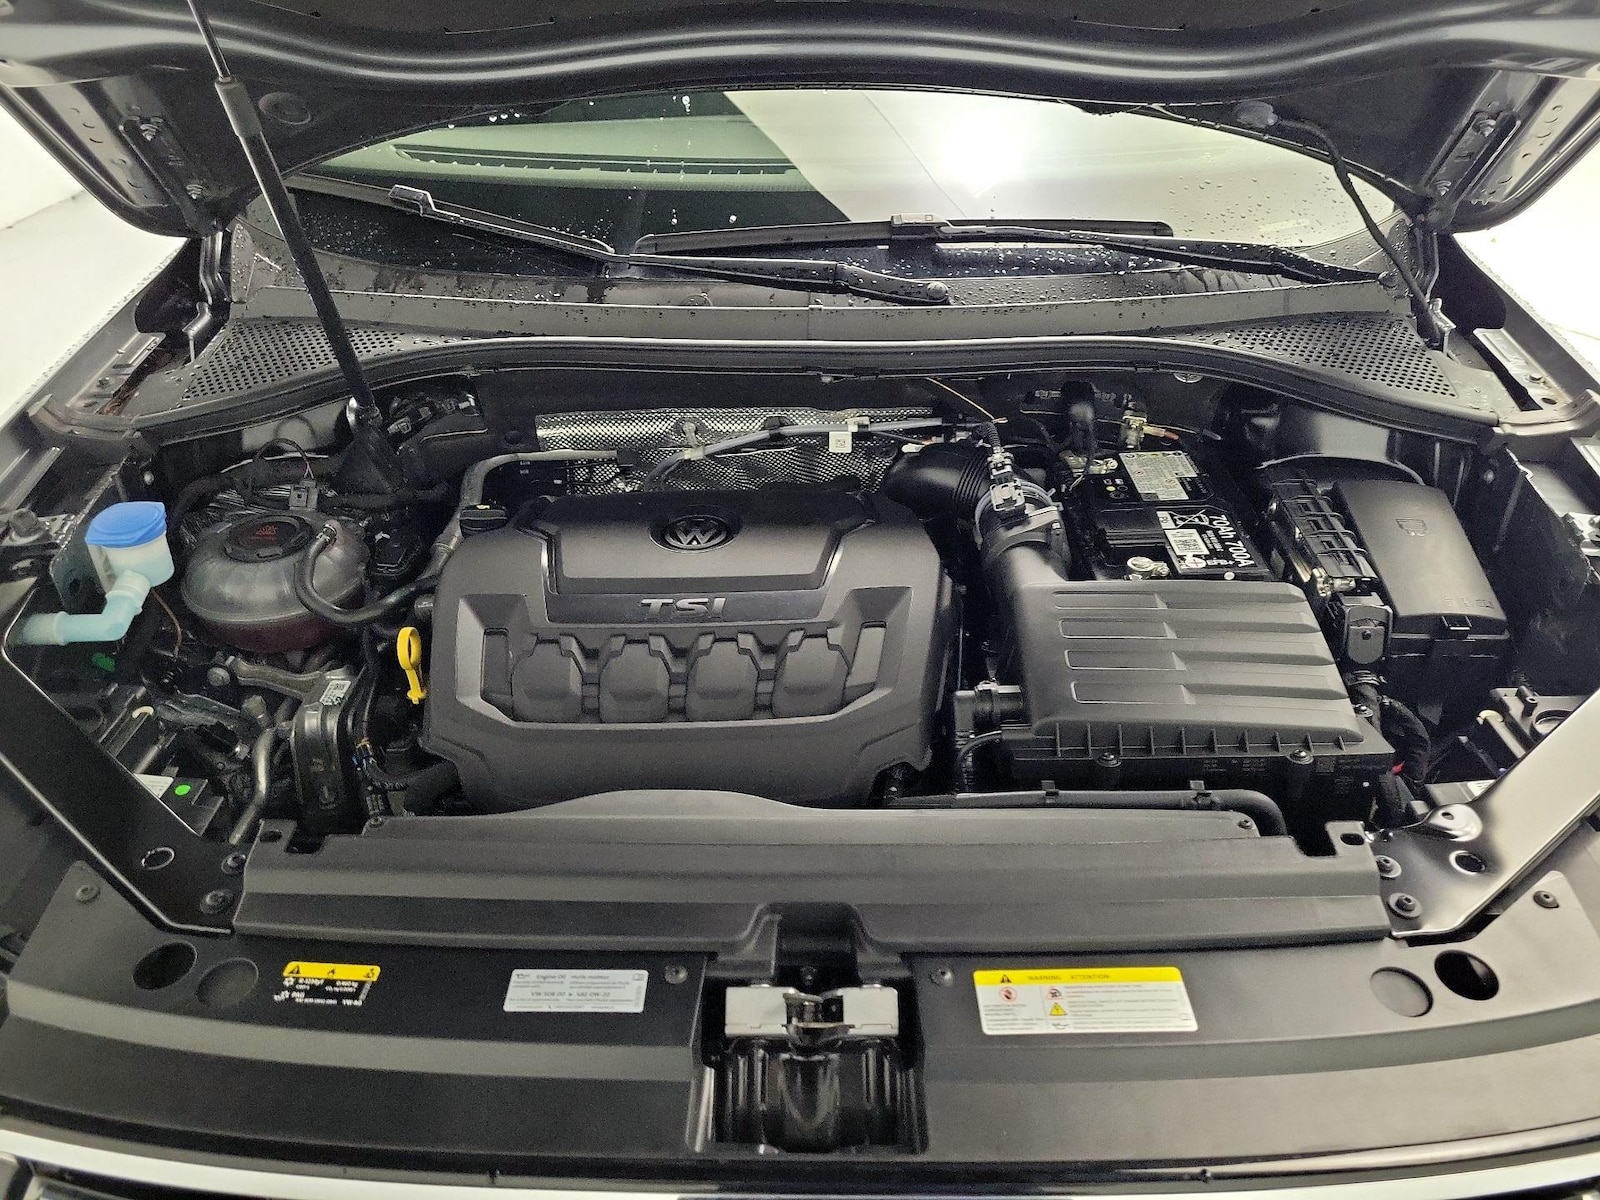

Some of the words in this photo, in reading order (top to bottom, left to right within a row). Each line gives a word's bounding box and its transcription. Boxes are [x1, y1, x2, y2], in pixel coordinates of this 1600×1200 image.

[1208, 514, 1237, 539] 70Ah
[1224, 540, 1255, 568] 700A
[640, 597, 727, 617] TSI
